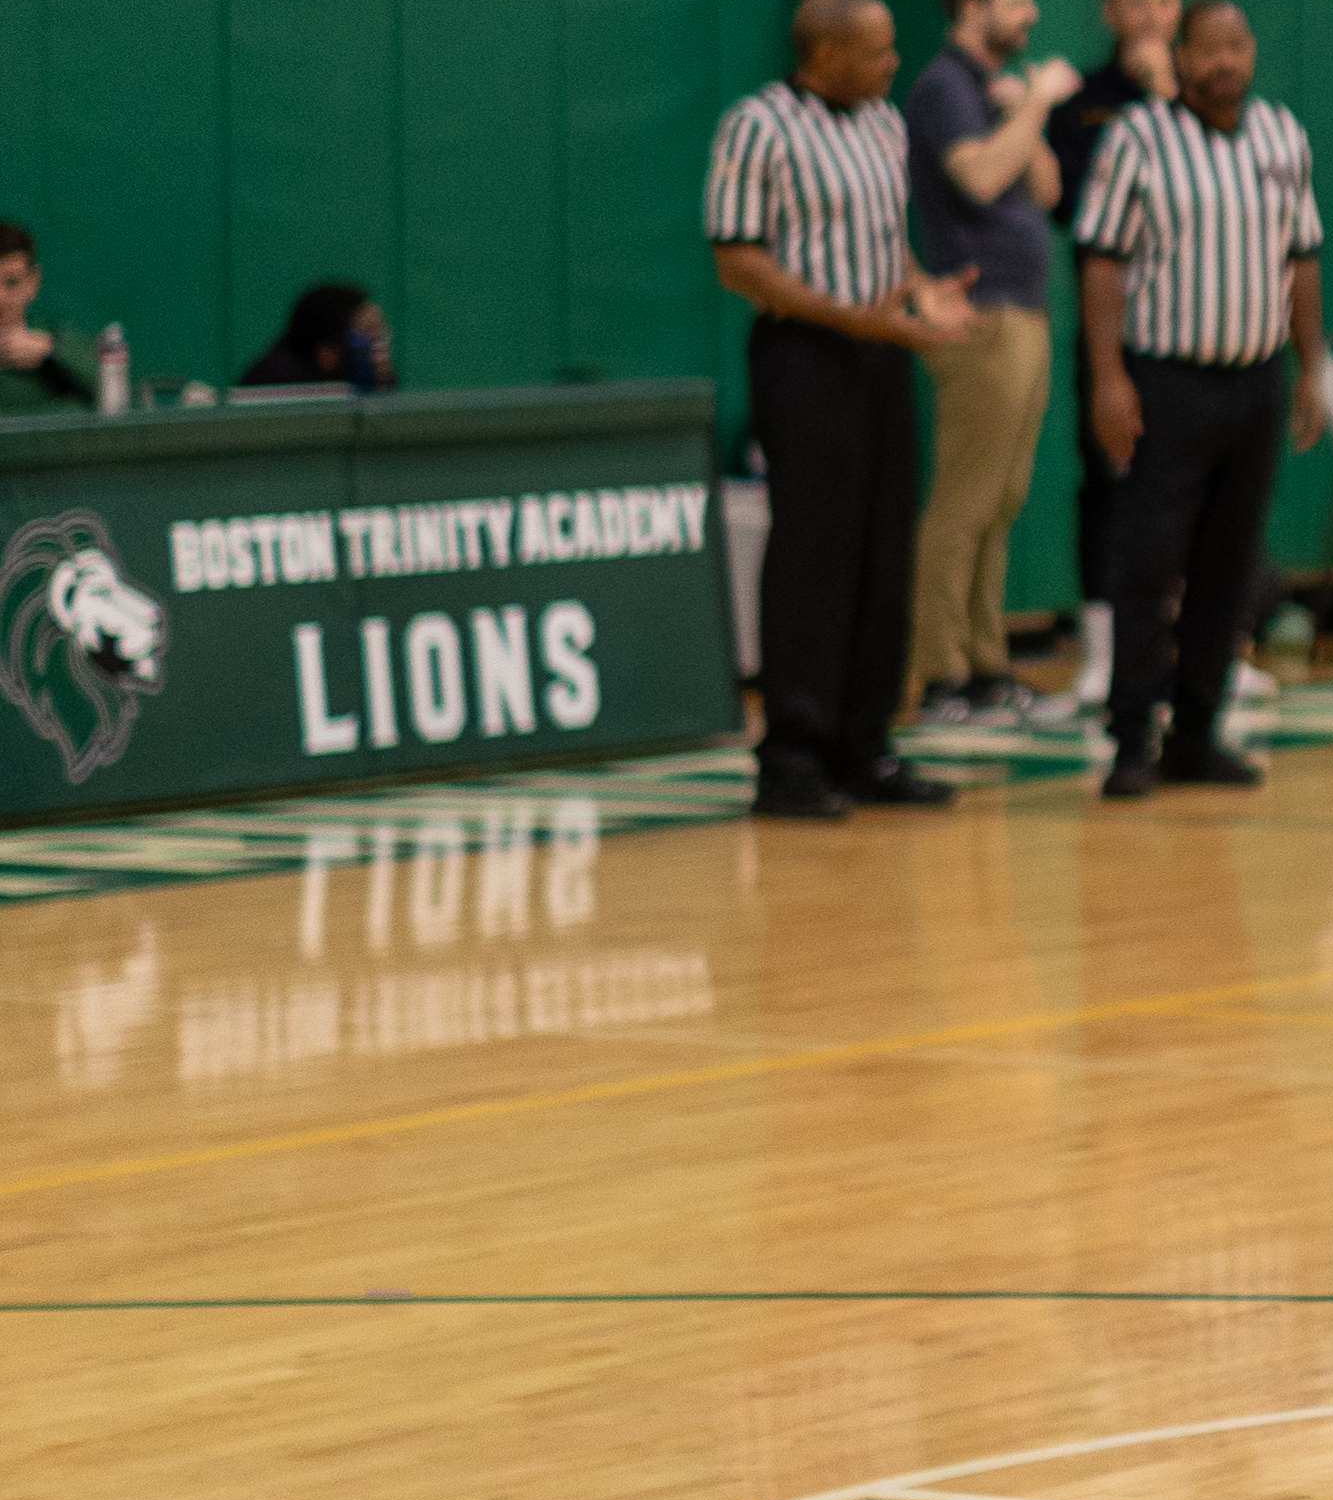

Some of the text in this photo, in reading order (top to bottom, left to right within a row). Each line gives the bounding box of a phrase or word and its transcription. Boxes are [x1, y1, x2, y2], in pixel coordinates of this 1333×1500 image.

[170, 480, 709, 593] BOSTON TRINITY ACADEMY
[294, 599, 601, 757] LIONS
